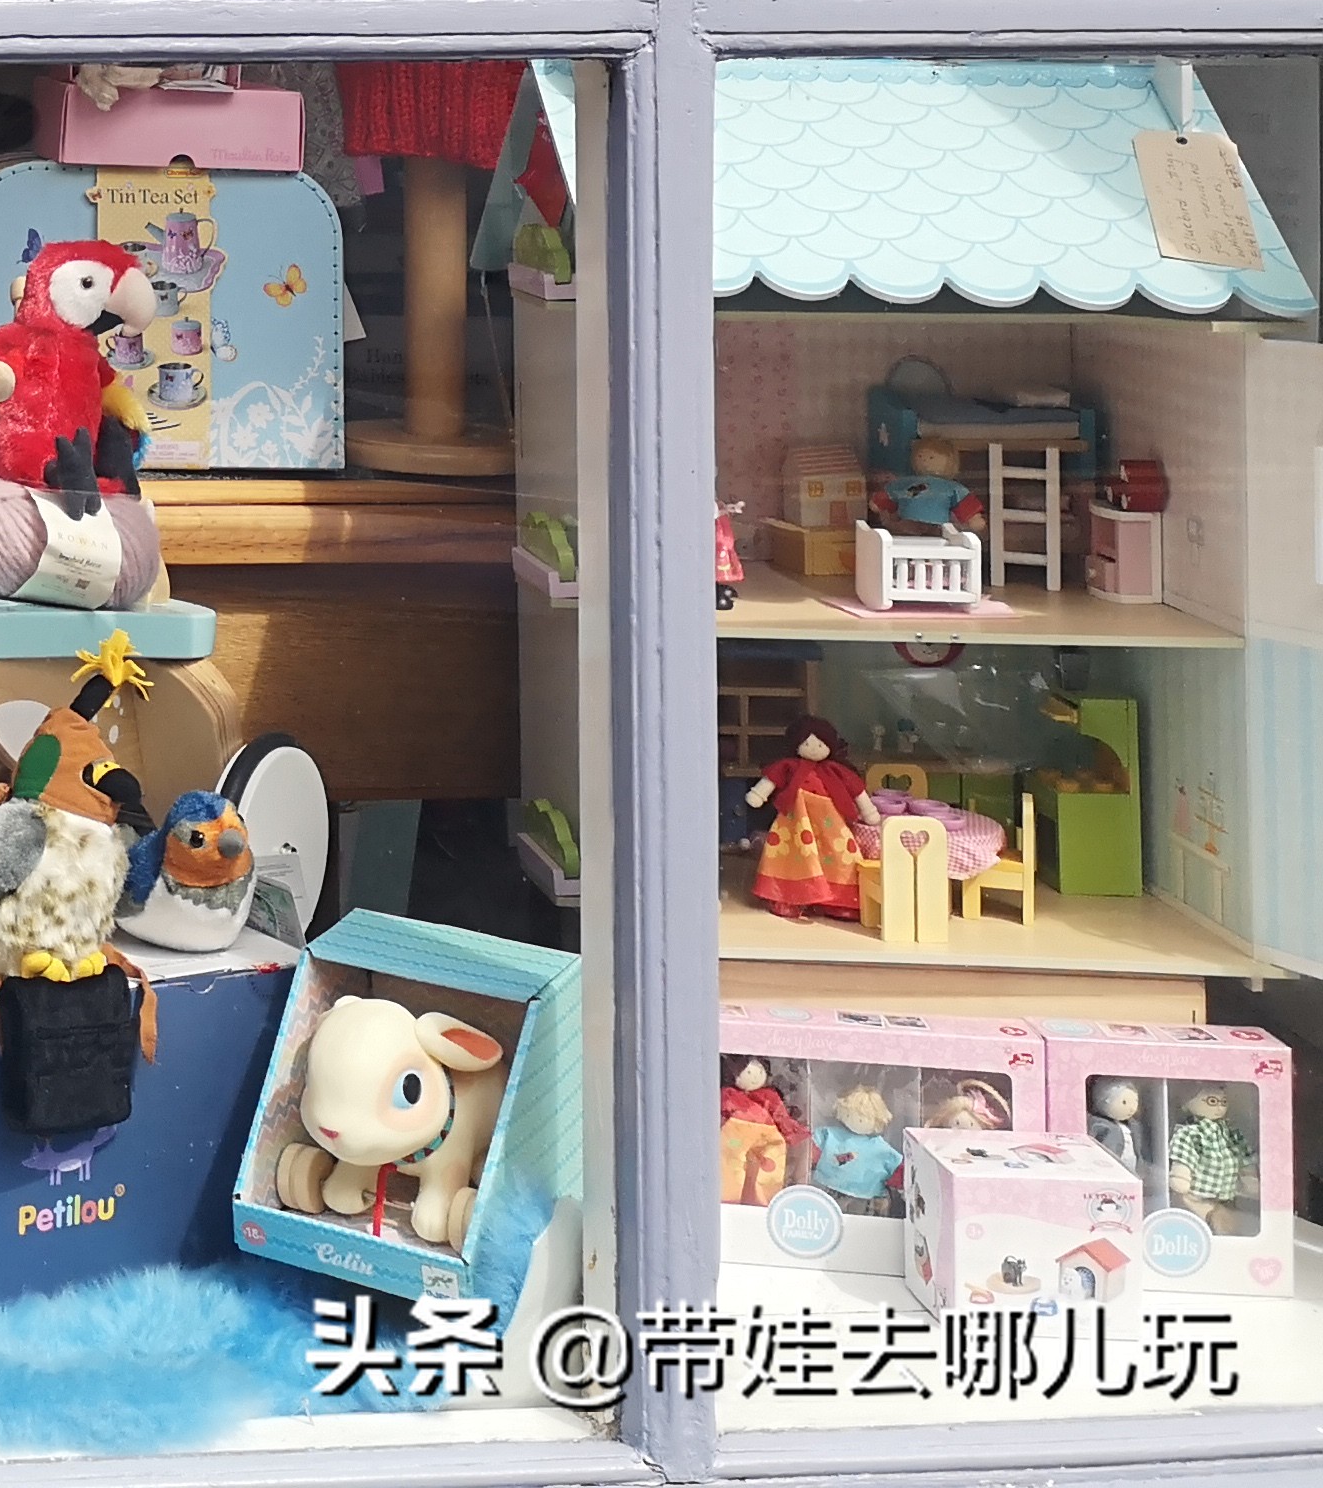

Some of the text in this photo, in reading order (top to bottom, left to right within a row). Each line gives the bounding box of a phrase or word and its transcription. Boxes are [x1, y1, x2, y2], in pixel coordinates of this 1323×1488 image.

[107, 188, 199, 205] Tin Tea Set
[58, 532, 108, 550] ROWAN
[17, 1194, 116, 1236] Petilou
[784, 1209, 830, 1240] Dolly
[1153, 1235, 1199, 1257] Dolls
